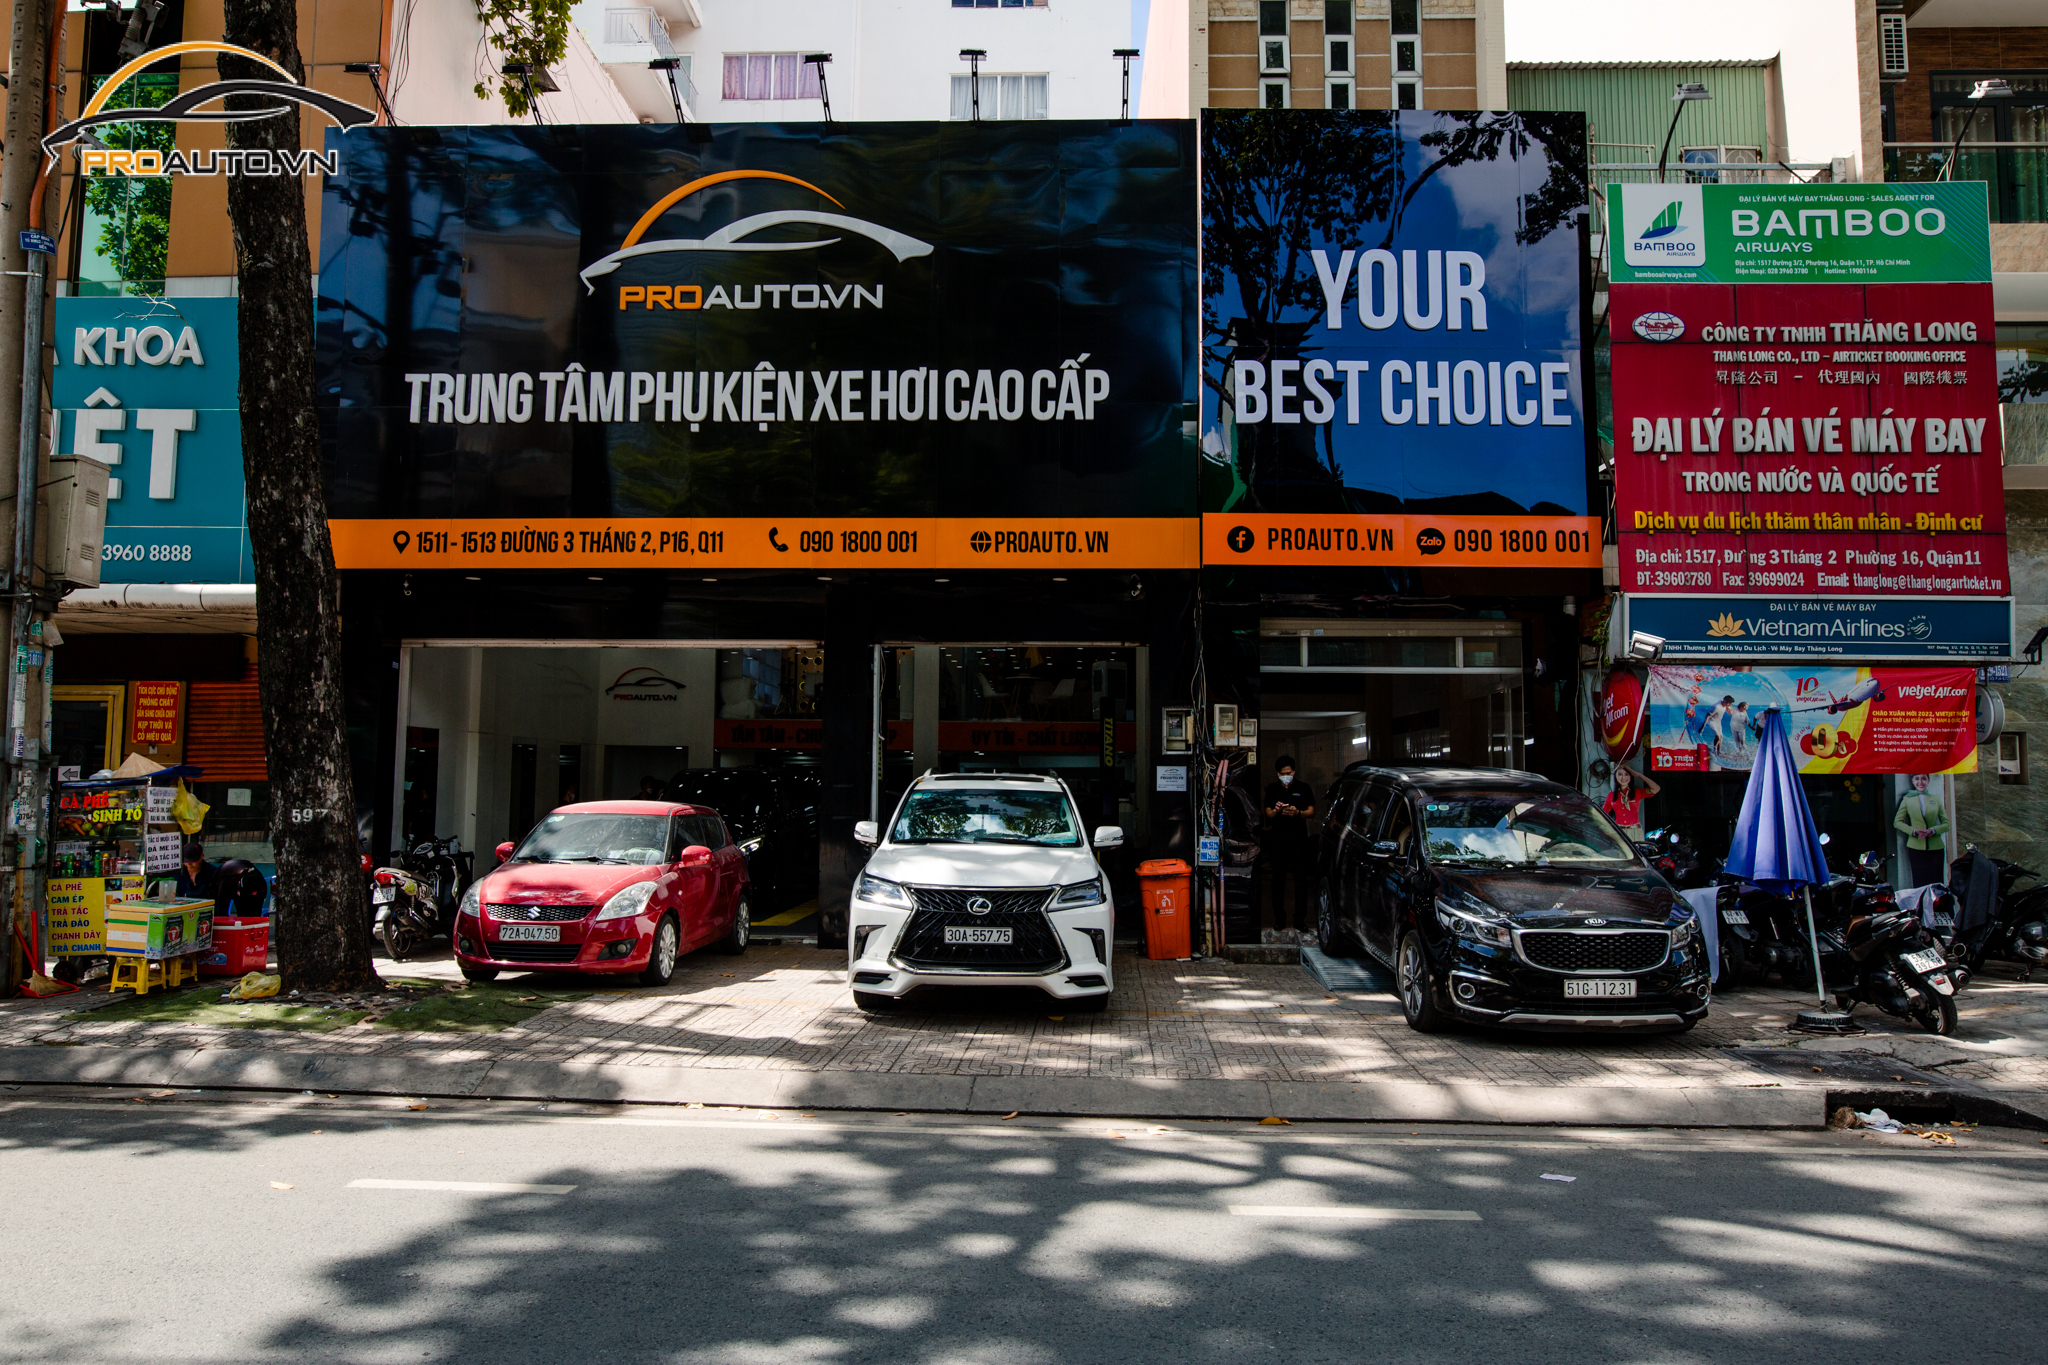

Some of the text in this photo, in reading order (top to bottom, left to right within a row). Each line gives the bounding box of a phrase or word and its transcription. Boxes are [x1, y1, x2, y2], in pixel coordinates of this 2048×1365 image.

[1788, 194, 1804, 202] MÁY
[1731, 208, 1946, 239] BAMBOO
[1634, 242, 1696, 251] BAMBOO
[1734, 242, 1813, 253] AIRWAYS
[619, 284, 883, 311] PROAUTO.VN
[1310, 249, 1489, 332] YOUR
[1702, 319, 1977, 342] CÔNG TY TNHH THĂNG LONG
[74, 326, 204, 366] KHOA
[1713, 351, 1748, 363] THANG
[1749, 351, 1775, 363] LONG
[1801, 351, 1820, 363] LTD
[1832, 351, 1883, 363] AIRTICKET
[1885, 351, 1930, 363] BOOKING
[1931, 351, 1966, 363] OFFICE
[404, 353, 1110, 432] TRUNG TÂM PHỤ KIỆN XE HƠI CAO CẤP
[1234, 360, 1572, 427] BEST CHOICE
[1632, 407, 1986, 462] ĐẠI LÝ BÁN VÉ MÁY BAY
[1682, 464, 1942, 496] TRONG NƯỚC VÀ QUỐC TẾ
[1634, 510, 1984, 536] Dịch vụ du lịch thăm thân nhân Định cư
[416, 526, 724, 556] 1511 1513 ĐƯỜNG 3 THÁNG 2, P16, Q11
[800, 530, 918, 553] 090 1800 001
[995, 531, 1108, 554] PROAUTO.VN
[1268, 527, 1394, 553] PROAUTO.VN
[1420, 536, 1442, 547] Zalo
[1454, 529, 1589, 553] 090 1800 001
[102, 544, 192, 562] 3960 8888
[1636, 549, 1657, 566] Địa
[1660, 548, 1682, 564] chỉ:
[1769, 549, 1780, 564] 3
[1781, 549, 1822, 566] Tháng
[1828, 550, 1837, 564] 2
[1846, 550, 1897, 567] Phường
[1902, 550, 1924, 567] 16,
[1926, 550, 1963, 568] Quận
[1965, 550, 1981, 565] 11
[1748, 572, 1804, 586] 39699024
[1817, 572, 1849, 587] Email:
[1770, 602, 1876, 614] ĐẠI LÝ BÁN VÉ MÁY BAY
[1105, 717, 1114, 767] TITANO
[1656, 755, 1673, 767] 10
[61, 792, 109, 809] CÀ PHÊ
[92, 809, 122, 822] SINH
[125, 803, 144, 821] TỐ
[51, 882, 82, 891] CÀ PHÊ
[72, 894, 84, 903] ÉP
[52, 907, 68, 916] TRÀ
[52, 918, 90, 928] TRÀ ĐÀO
[84, 930, 101, 939] DÂY
[502, 926, 558, 940] 72A-047.50
[947, 928, 1011, 943] 30A-557.75
[52, 943, 101, 952] TRÀ CHANH
[1566, 981, 1634, 996] 51G-112.31
